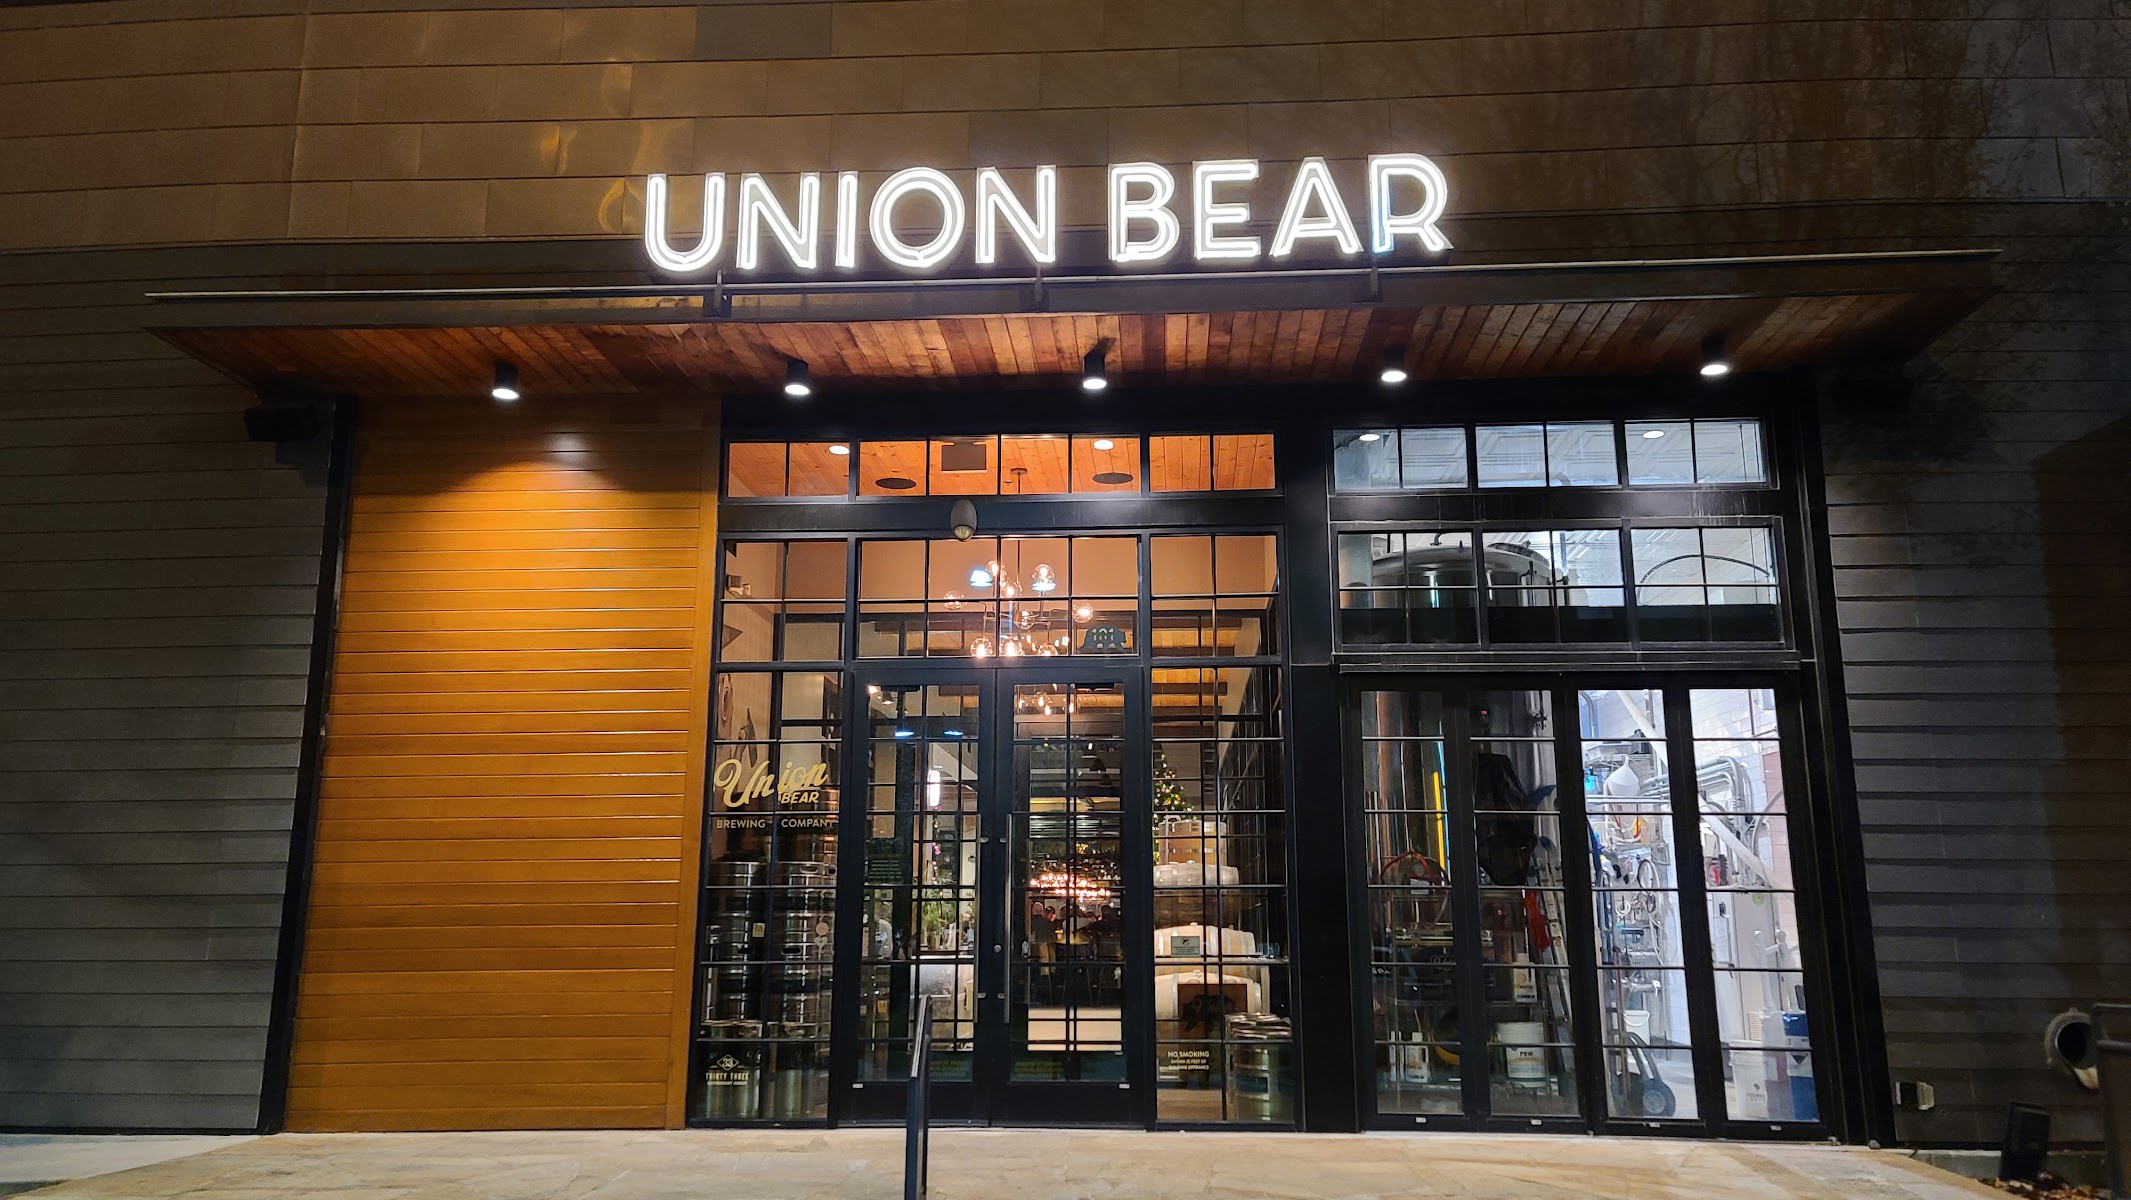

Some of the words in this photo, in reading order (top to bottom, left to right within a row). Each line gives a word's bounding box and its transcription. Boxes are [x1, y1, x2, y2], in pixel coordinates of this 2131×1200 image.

[643, 165, 1057, 272] UNION
[1107, 152, 1453, 264] BEAR
[714, 758, 828, 808] Union
[780, 791, 820, 804] BEAR
[716, 819, 766, 829] BREWING
[781, 818, 834, 828] COMPANY
[1167, 1050, 1178, 1058] NO
[1179, 1050, 1210, 1058] SMOKING
